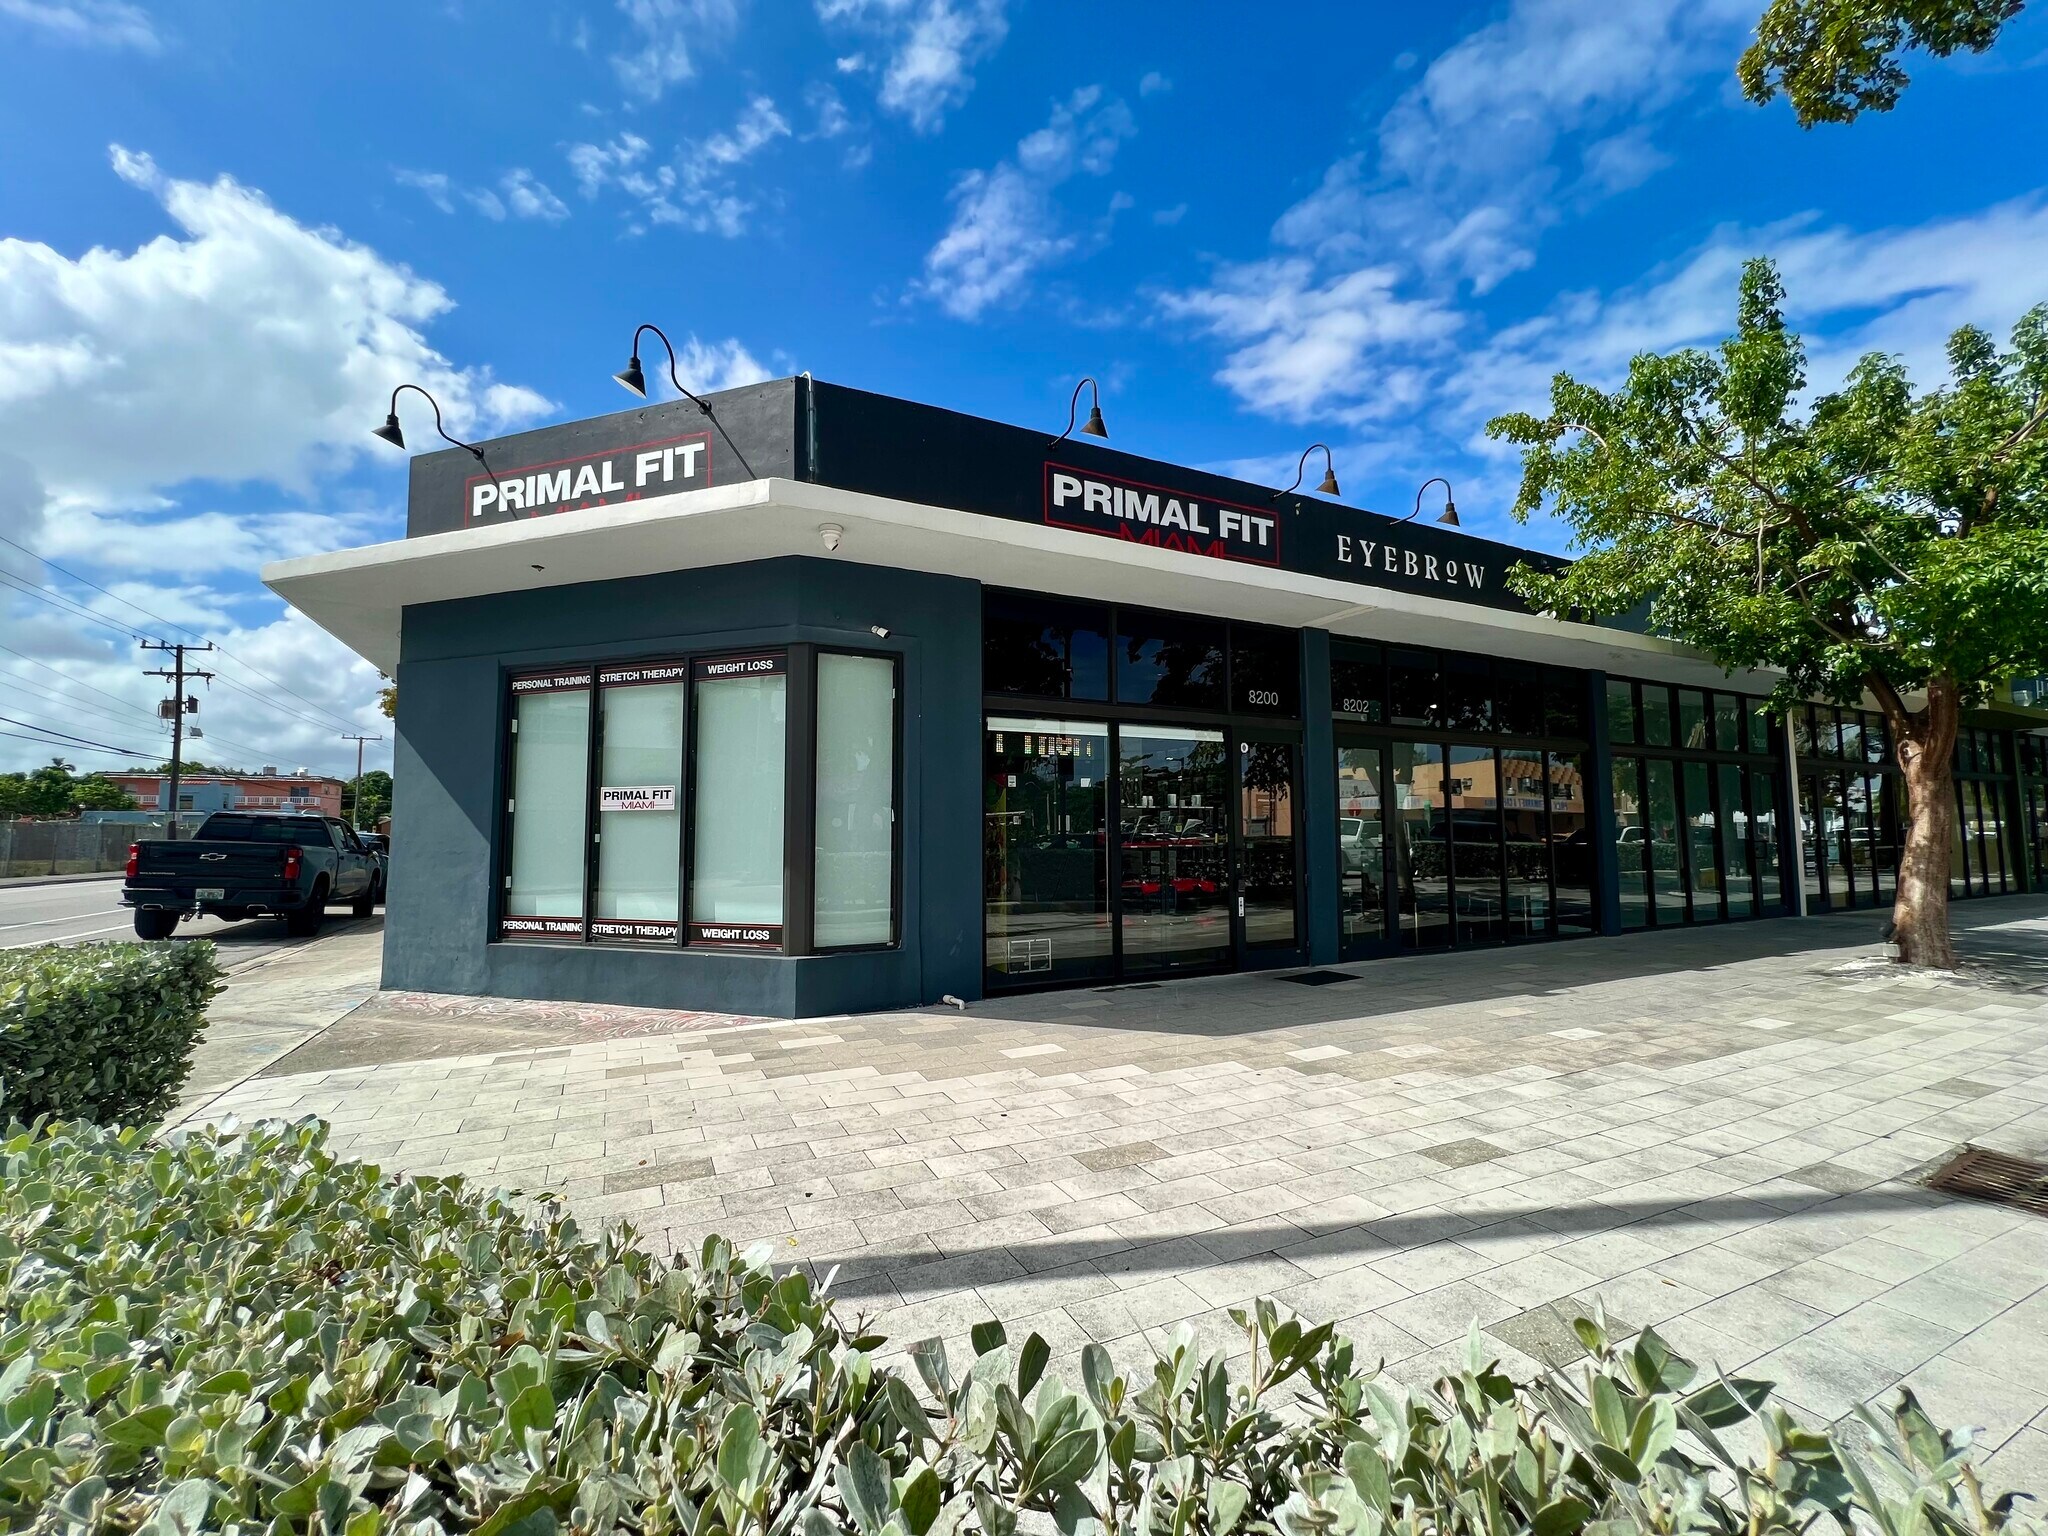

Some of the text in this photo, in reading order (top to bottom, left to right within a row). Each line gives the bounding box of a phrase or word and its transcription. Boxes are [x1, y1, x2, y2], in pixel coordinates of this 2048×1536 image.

[473, 461, 625, 517] PRIMAL
[636, 442, 705, 487] FIT
[1053, 473, 1275, 546] PRIMAL FIT
[599, 667, 684, 683] STRETCH THERAPY
[707, 660, 774, 675] WEIGHT LOSS
[512, 675, 591, 690] PERSONAL TRAINING
[1248, 689, 1279, 706] 8200
[1343, 698, 1370, 713] 8202
[603, 789, 672, 801] PRIMAL FIT
[621, 800, 655, 810] MIAMI
[502, 920, 583, 932] PERSONAL TRAINING
[591, 923, 678, 937] STRETCH THERAPY
[701, 928, 770, 941] WEIGHT LOSS
